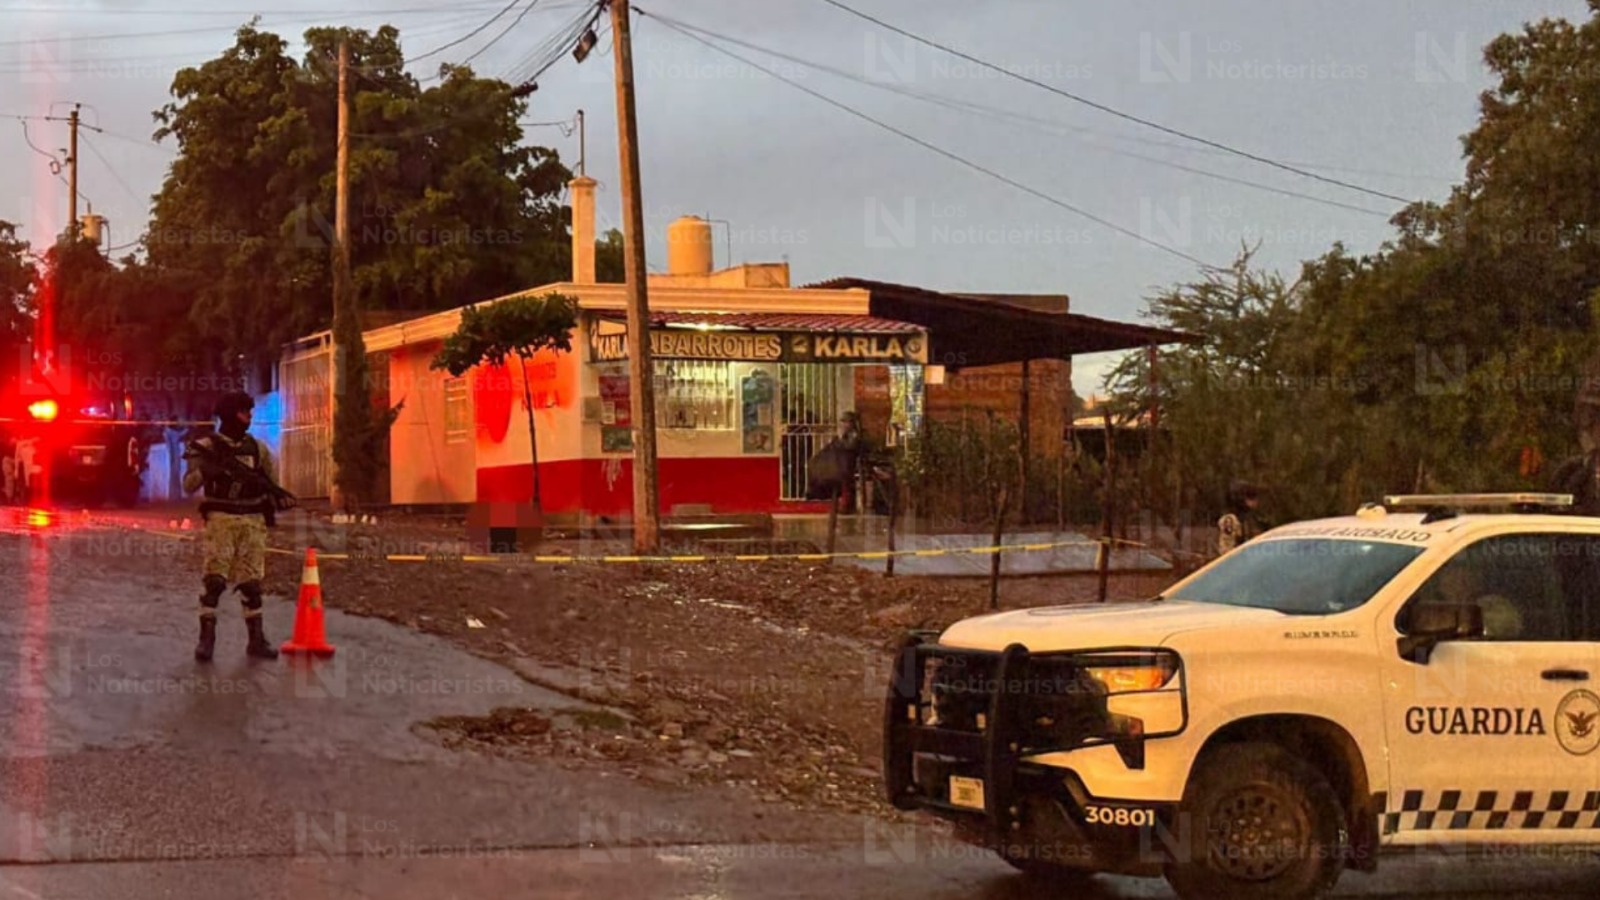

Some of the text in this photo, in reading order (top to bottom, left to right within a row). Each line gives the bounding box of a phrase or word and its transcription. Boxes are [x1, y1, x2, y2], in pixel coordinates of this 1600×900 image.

[814, 336, 904, 358] KARLA
[1405, 706, 1546, 736] GUARDIA
[1084, 805, 1155, 827] 30801
